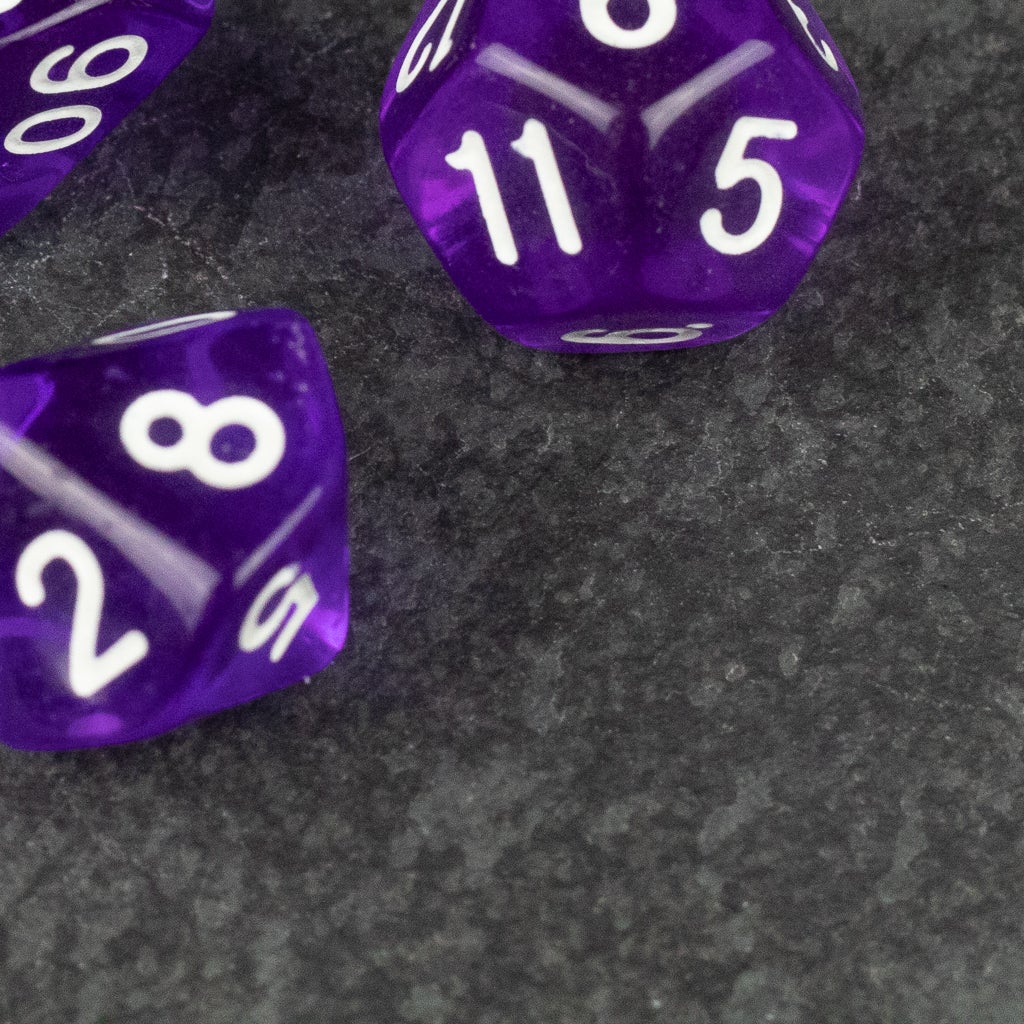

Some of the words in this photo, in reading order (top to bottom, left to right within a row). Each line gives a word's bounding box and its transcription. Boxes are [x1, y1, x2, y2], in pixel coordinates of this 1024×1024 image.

[444, 118, 584, 267] 11
[699, 116, 799, 256] 5
[118, 388, 287, 491] 8
[14, 528, 150, 700] 2
